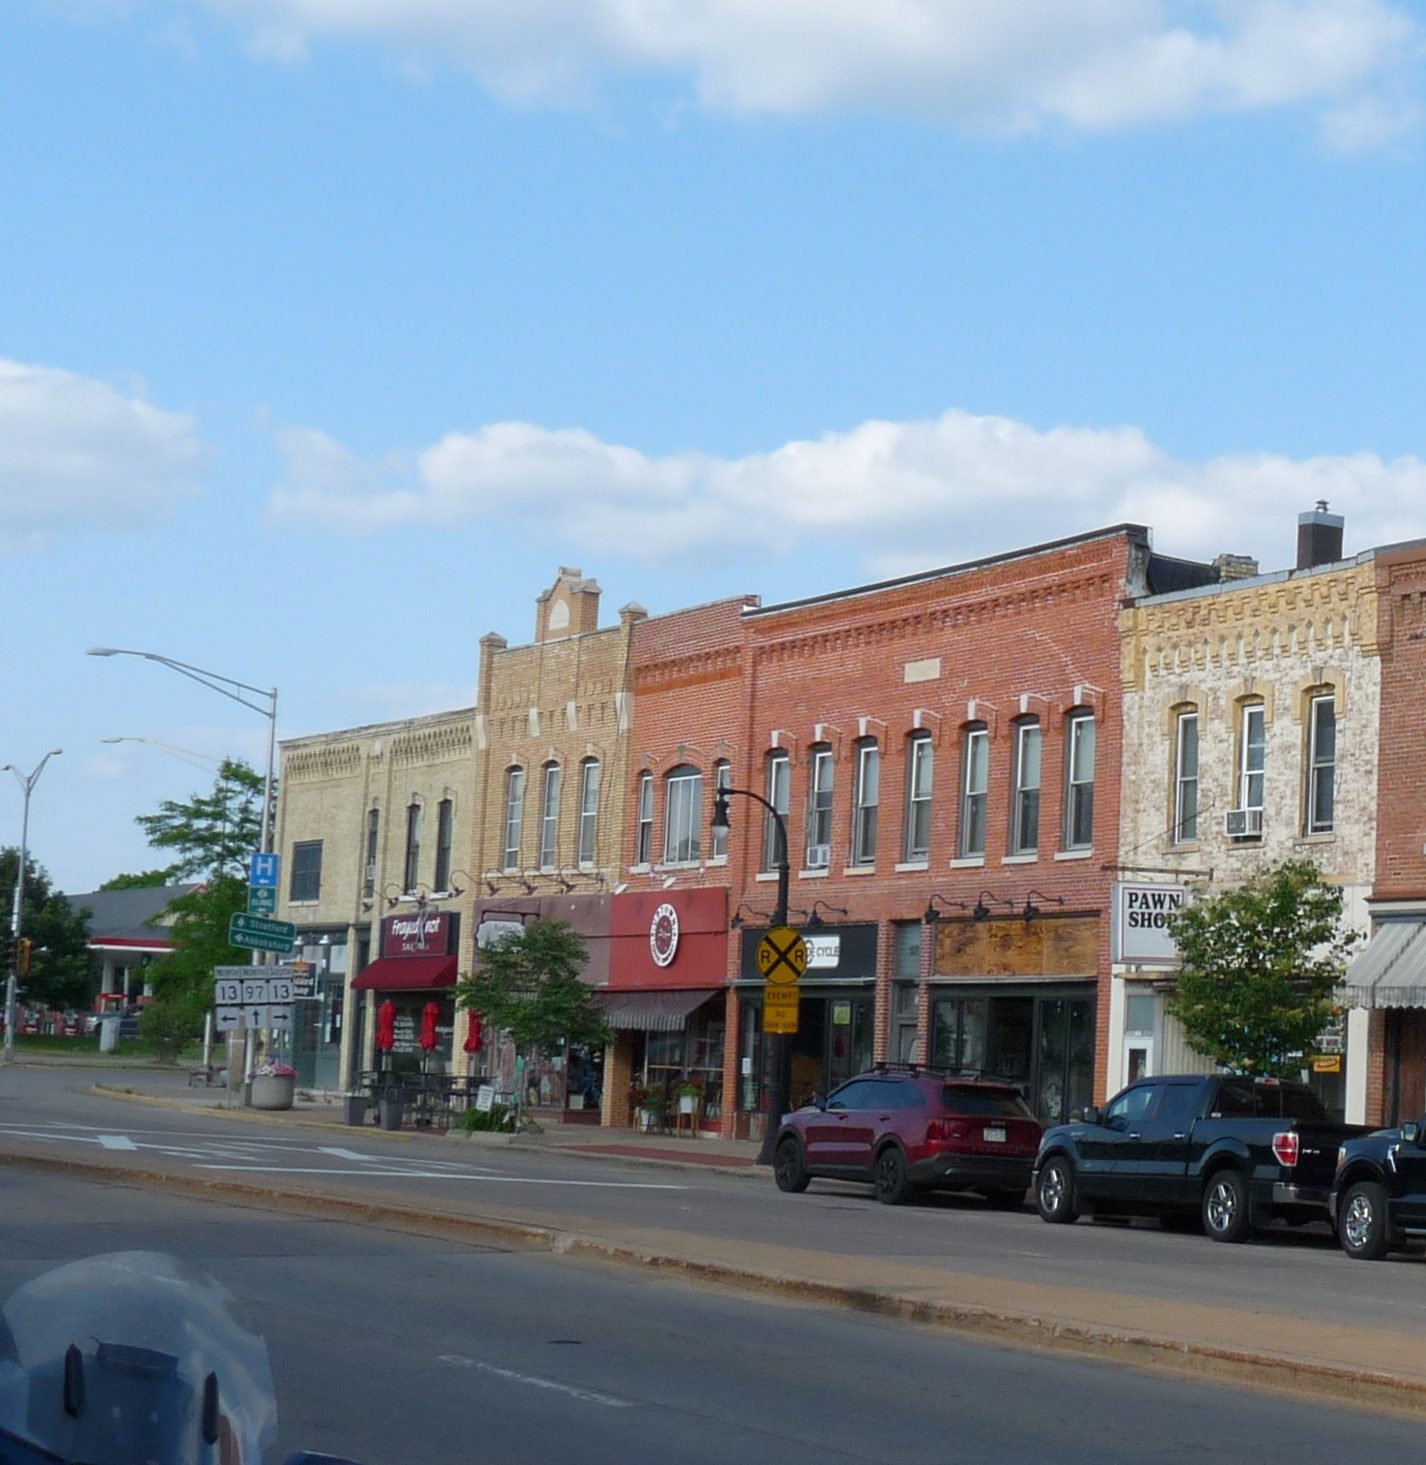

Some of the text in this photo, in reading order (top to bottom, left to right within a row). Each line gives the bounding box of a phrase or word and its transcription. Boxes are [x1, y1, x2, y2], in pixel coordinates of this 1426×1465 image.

[256, 857, 273, 876] H
[1127, 892, 1181, 910] PAWN
[1128, 911, 1178, 929] SHOP
[761, 949, 805, 963] R R
[221, 984, 290, 1000] 13 97 13
